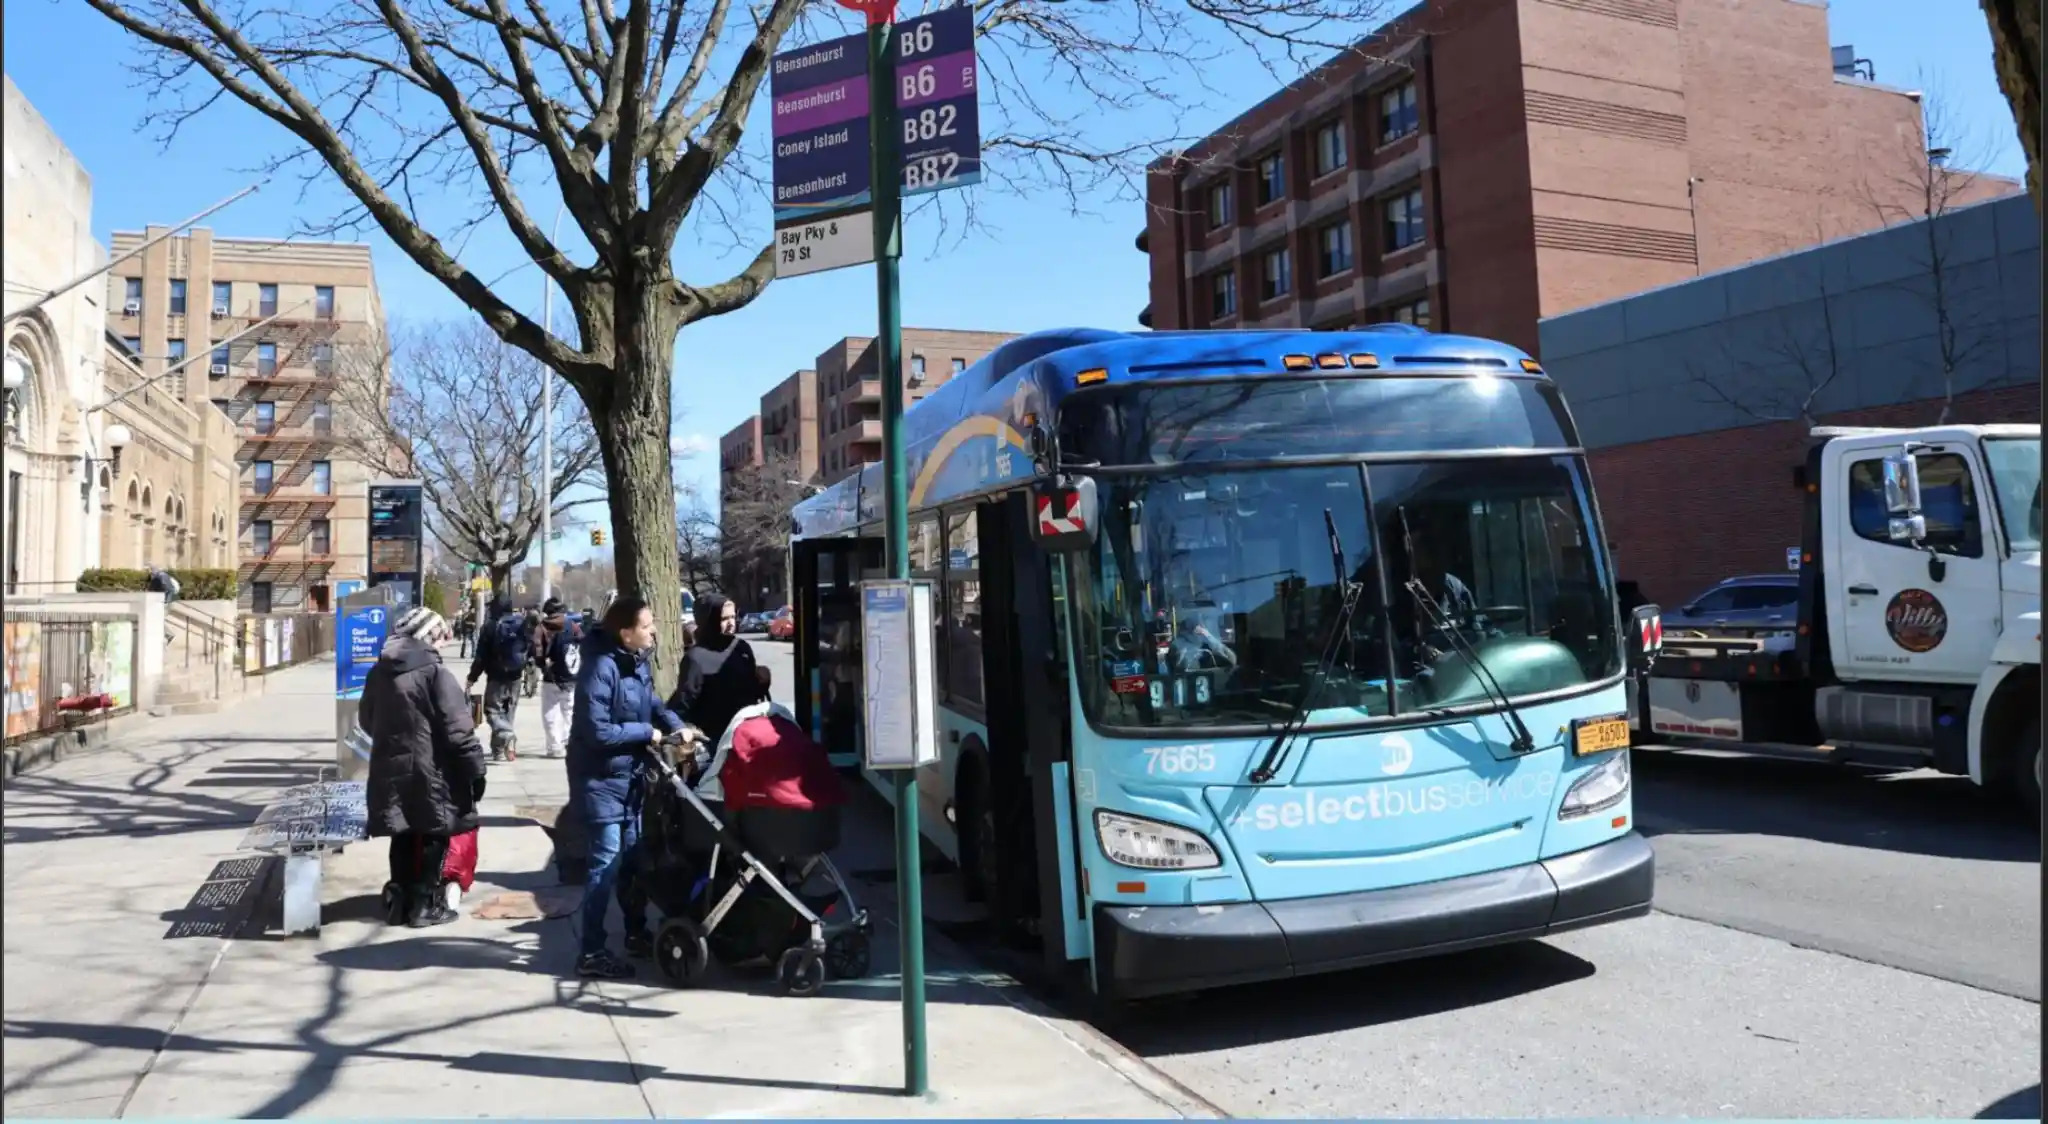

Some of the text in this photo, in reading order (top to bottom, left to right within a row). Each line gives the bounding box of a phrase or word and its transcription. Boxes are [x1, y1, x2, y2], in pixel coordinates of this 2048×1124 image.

[901, 22, 934, 57] B6
[776, 46, 844, 74] Bensonhurst
[902, 65, 973, 100] B6 LTD
[777, 87, 846, 115] Bensonhurst
[904, 105, 957, 144] B82
[778, 128, 848, 157] Coney Island
[778, 172, 847, 200] Bensonhurst
[906, 152, 960, 191] B82
[781, 222, 838, 246] Bay Pky &
[782, 246, 811, 263] 79 St
[1143, 744, 1216, 775] 7665
